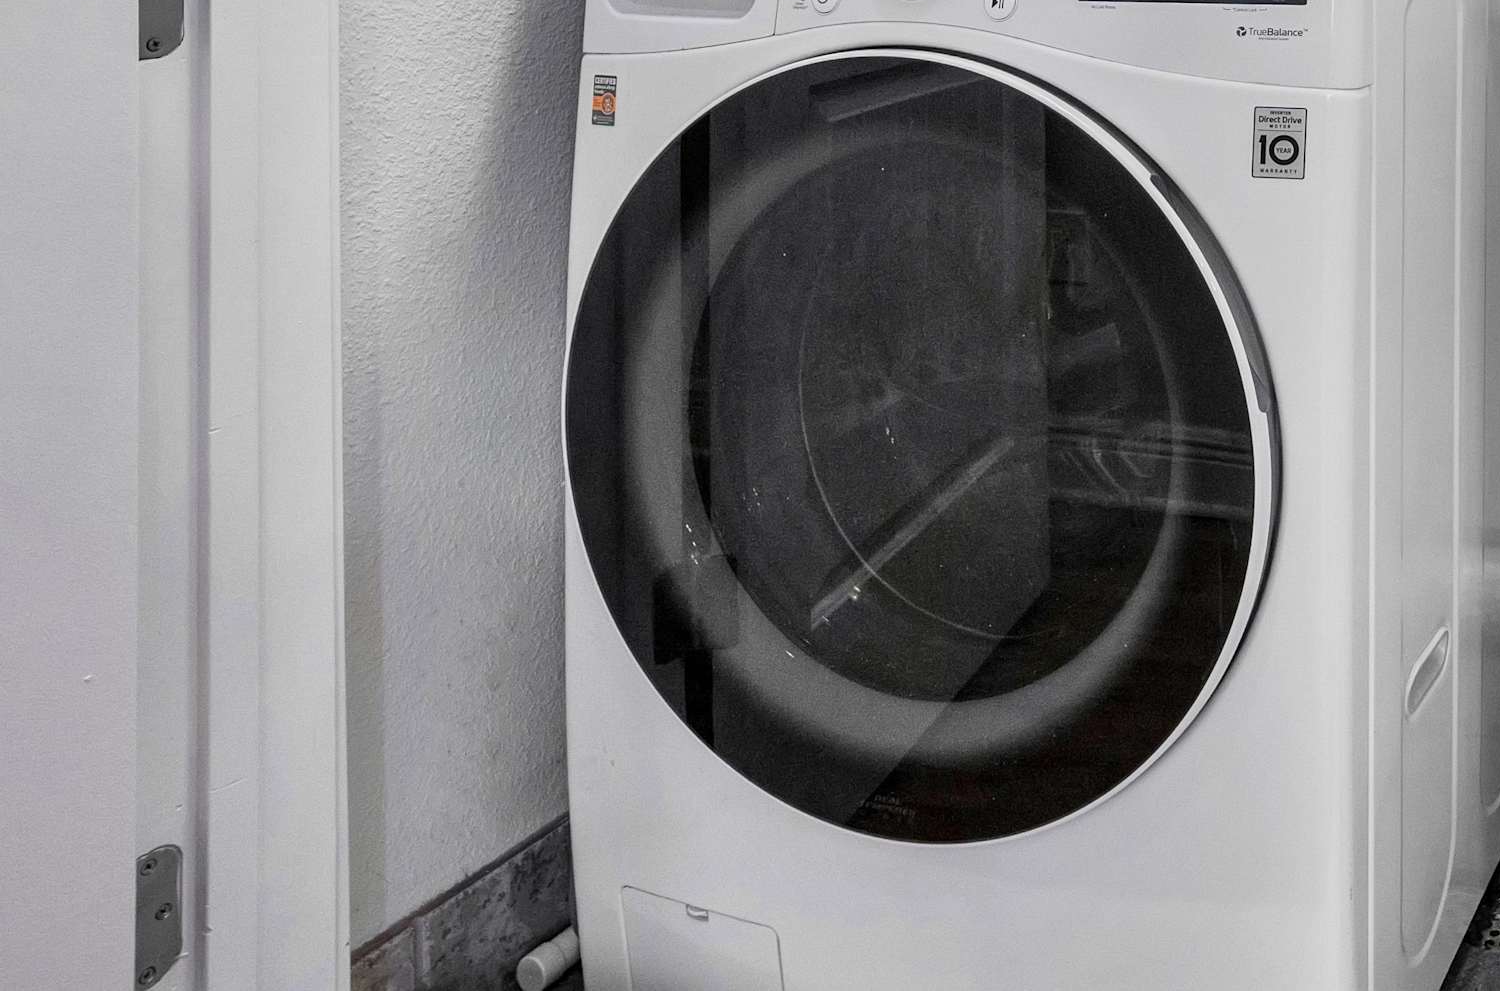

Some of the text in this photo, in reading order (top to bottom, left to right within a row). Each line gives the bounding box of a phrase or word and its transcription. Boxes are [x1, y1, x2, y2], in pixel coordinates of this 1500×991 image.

[1258, 115, 1302, 125] Direct Drive
[1259, 134, 1300, 166] 10
